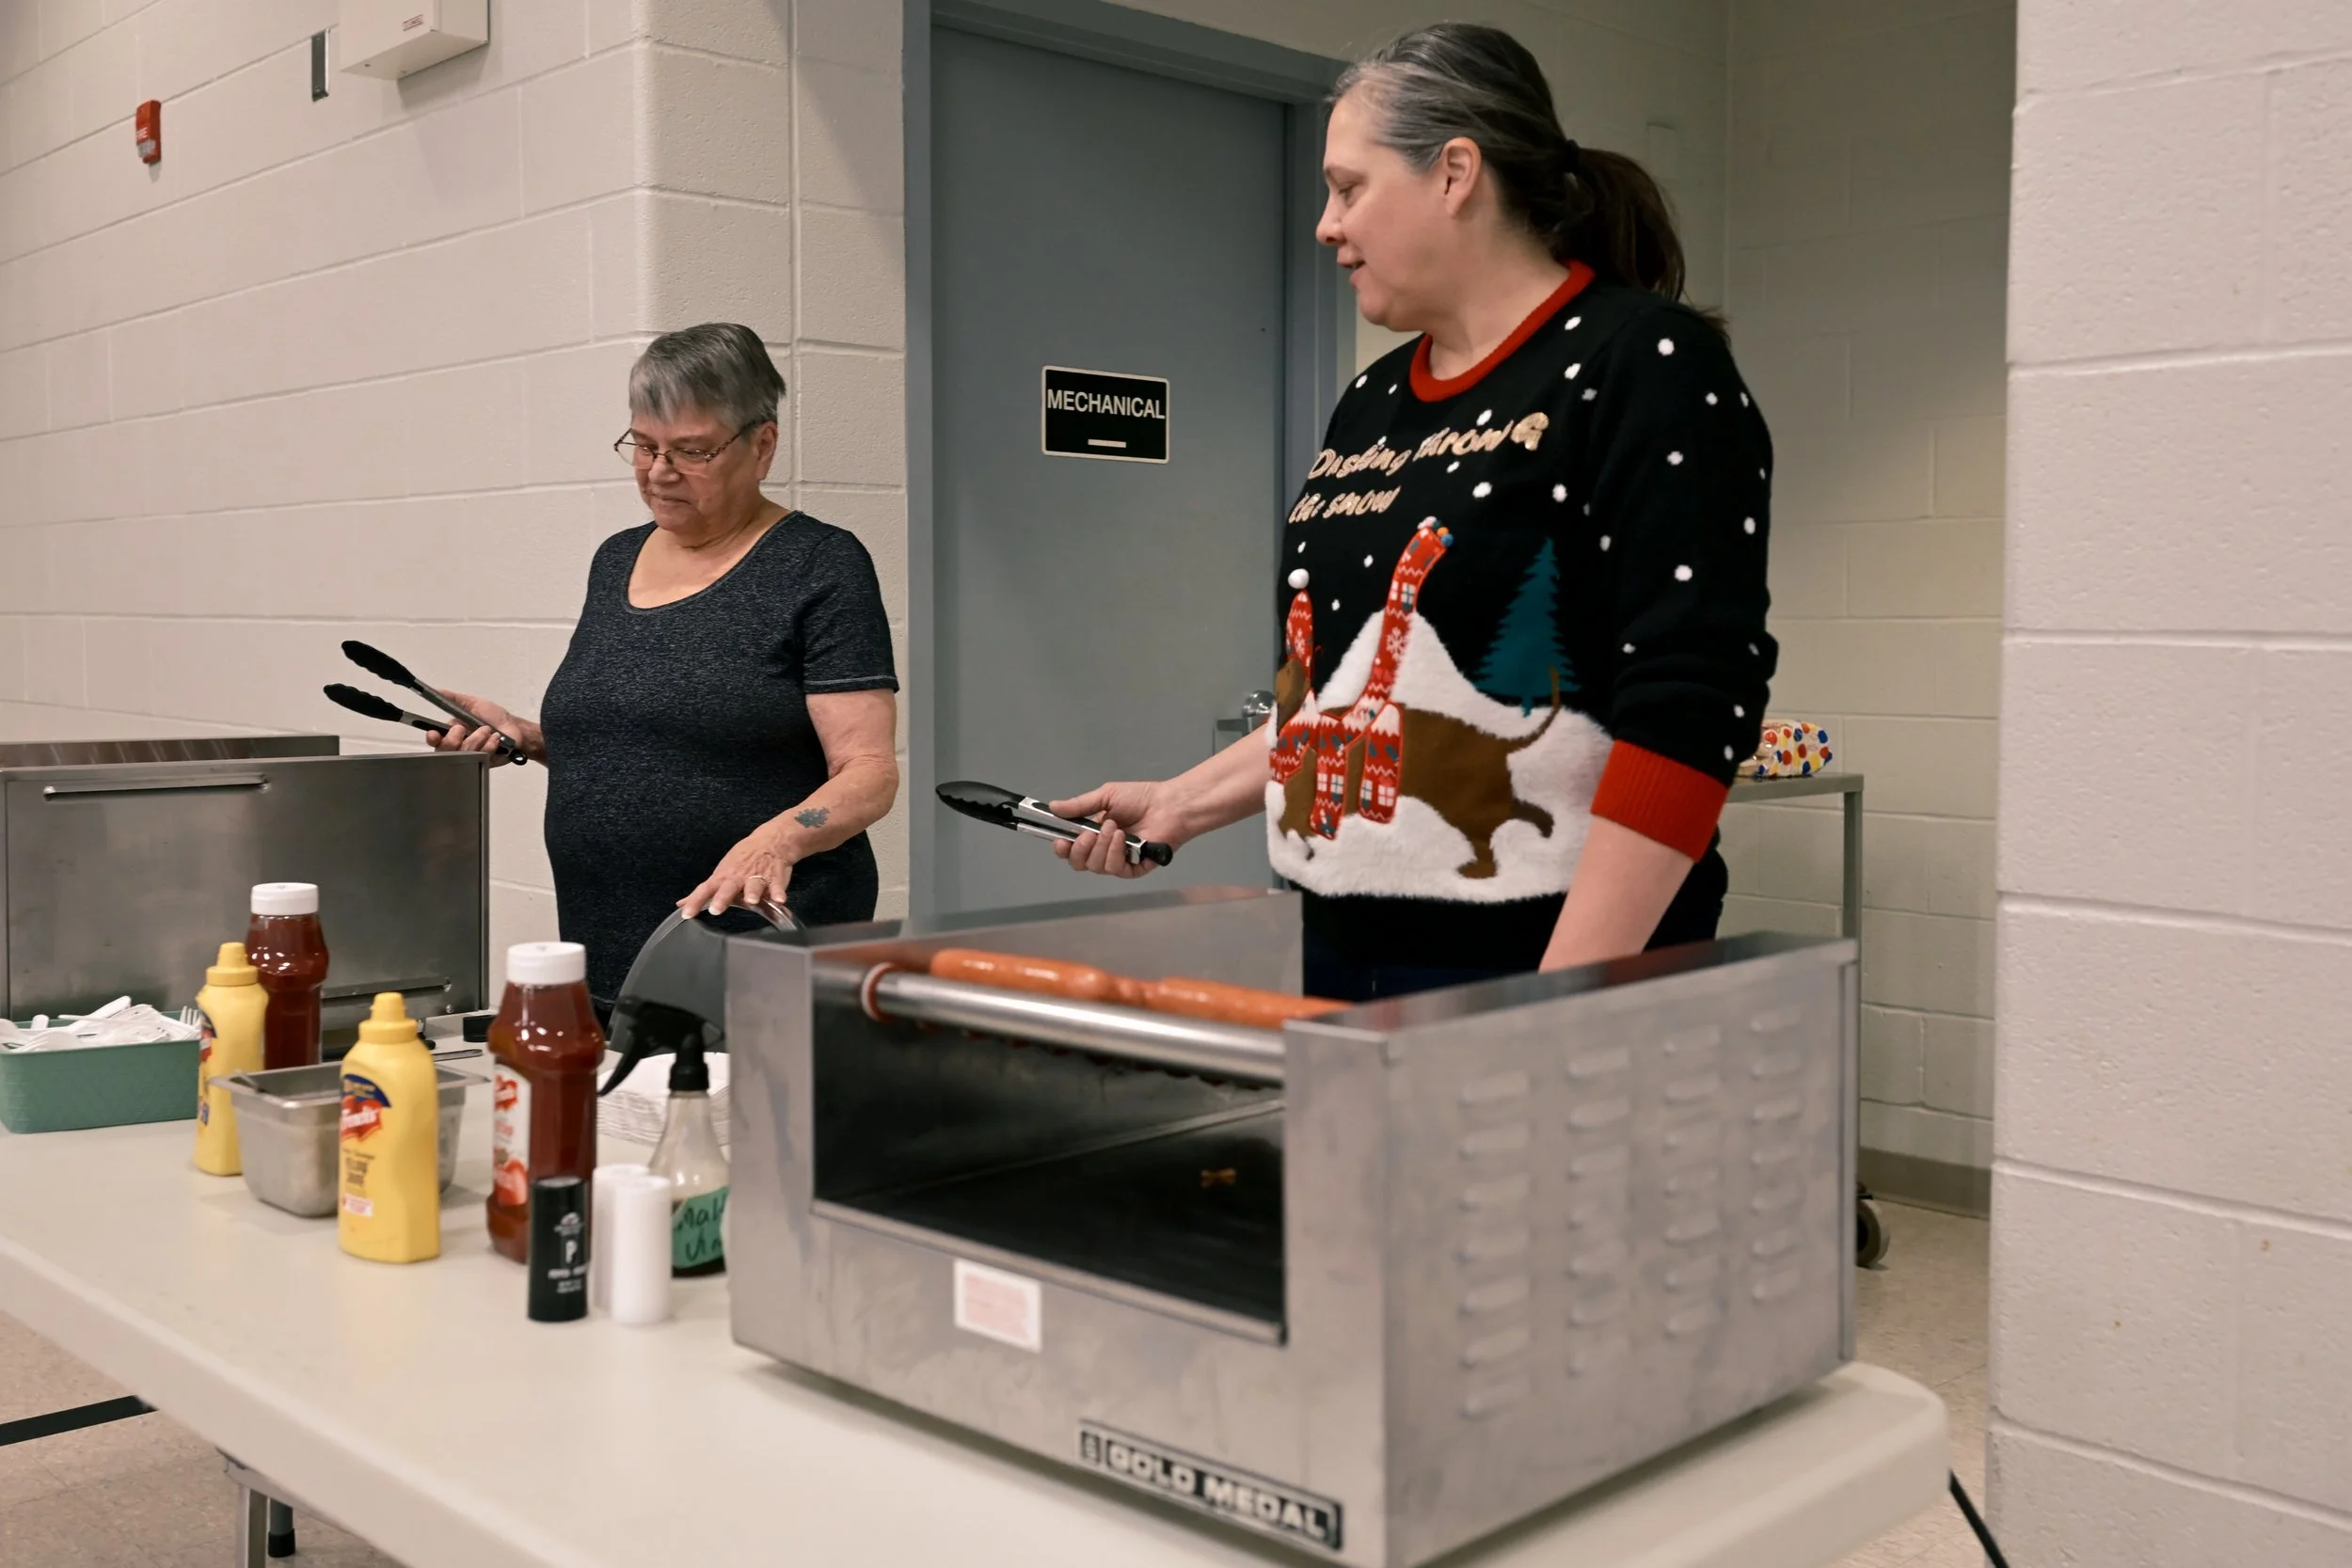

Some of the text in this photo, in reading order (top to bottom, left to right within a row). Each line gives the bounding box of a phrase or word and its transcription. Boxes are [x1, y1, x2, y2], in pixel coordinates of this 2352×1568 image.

[1047, 388, 1166, 420] MECHANICAL
[1323, 485, 1401, 518] snow
[1108, 1442, 1196, 1497] GOLD
[1204, 1473, 1327, 1541] MEDAL
